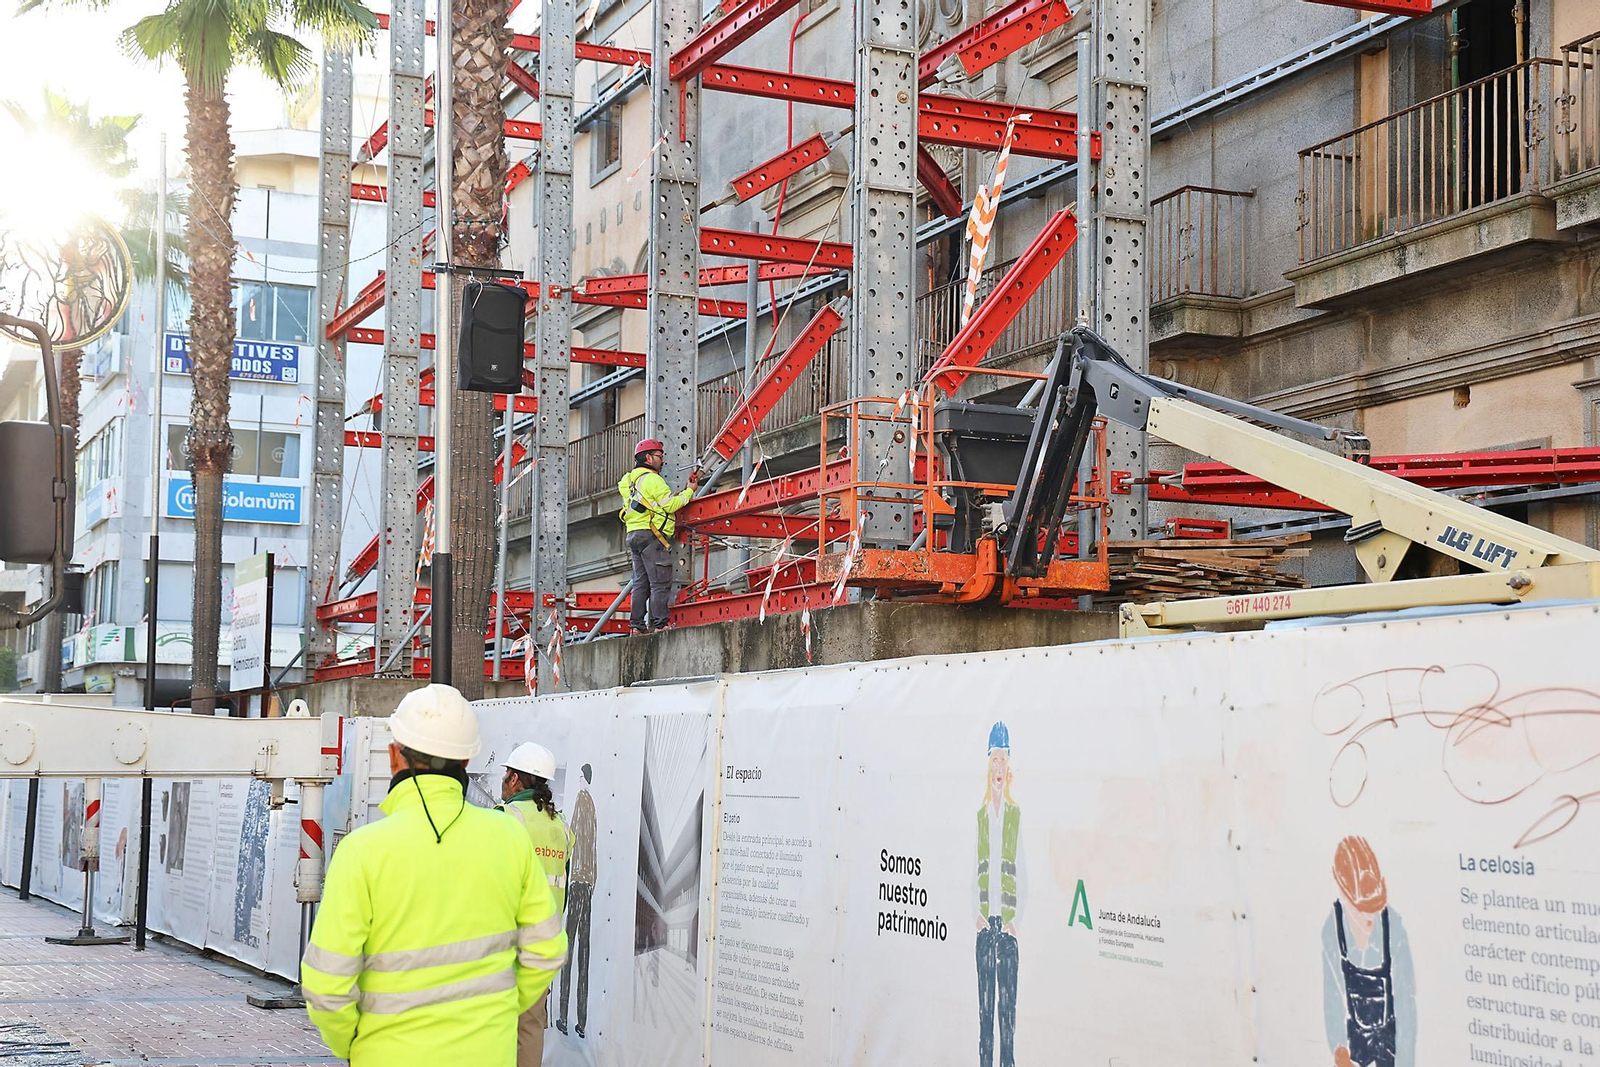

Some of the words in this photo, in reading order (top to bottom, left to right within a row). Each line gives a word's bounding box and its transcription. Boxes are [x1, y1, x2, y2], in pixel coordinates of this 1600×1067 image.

[1437, 526, 1474, 552] JLG
[1472, 538, 1518, 568] LIFT
[1234, 598, 1250, 614] 617
[1253, 596, 1270, 612] 440
[1273, 596, 1290, 610] 274
[726, 766, 734, 779] El
[736, 766, 762, 783] espacio
[729, 813, 740, 825] patio
[880, 848, 921, 876] Somos
[1460, 853, 1476, 871] La
[1480, 855, 1534, 876] celosía
[879, 882, 928, 907] nuestro
[1460, 887, 1478, 904] Se
[1483, 889, 1540, 910] plantea
[1545, 899, 1566, 913] un
[878, 909, 947, 942] patrimonio
[1099, 909, 1116, 921] Junta
[1118, 912, 1126, 923] de
[1127, 913, 1161, 928] Andalucía
[1462, 914, 1530, 936] elemento
[1464, 943, 1526, 962] carácter
[1466, 965, 1482, 983] de
[1488, 972, 1507, 987] un
[1512, 972, 1570, 996] edificio
[1467, 995, 1544, 1020] estructura
[1550, 1008, 1566, 1023] se
[1468, 1018, 1558, 1049] distribuidor
[1564, 1038, 1573, 1052] a
[1579, 1036, 1594, 1055] la
